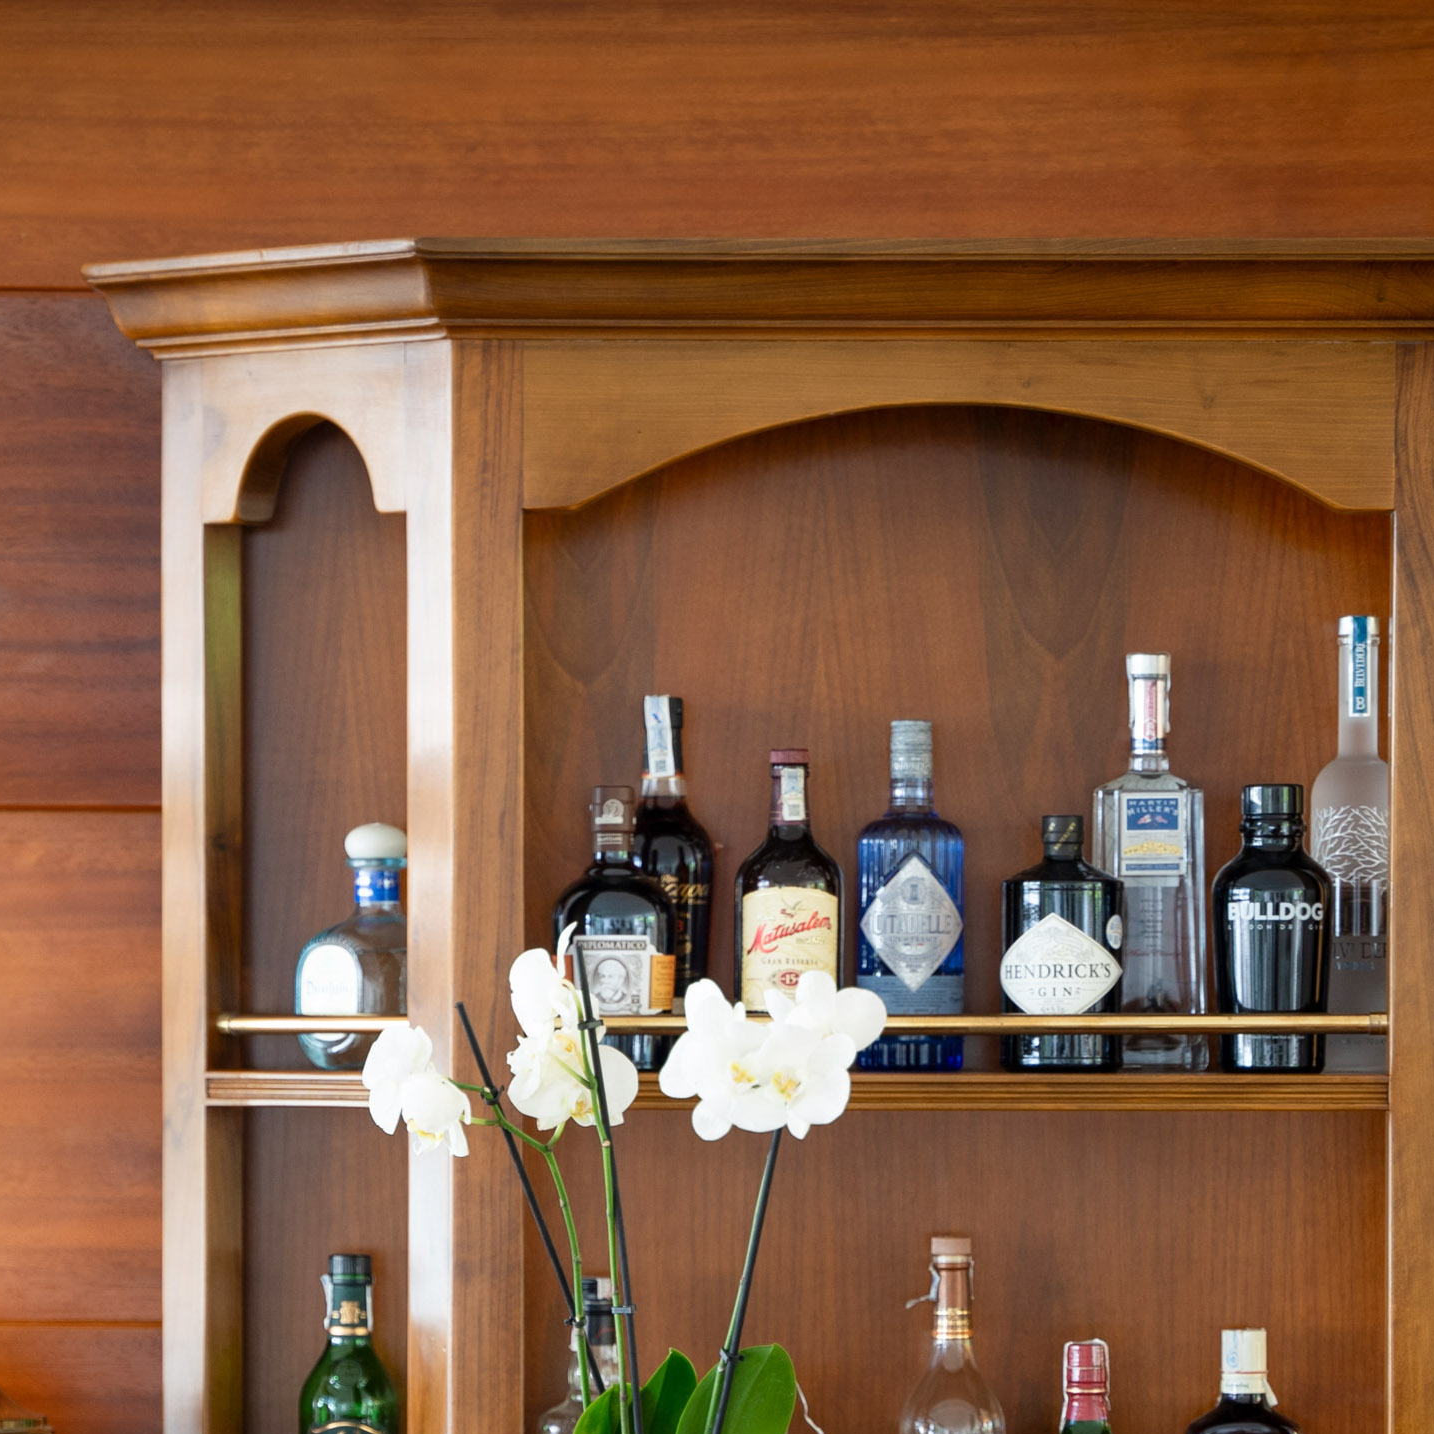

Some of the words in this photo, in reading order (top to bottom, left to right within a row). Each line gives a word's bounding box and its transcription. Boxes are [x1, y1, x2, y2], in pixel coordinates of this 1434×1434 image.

[1127, 805, 1179, 817] MILLER'S
[1228, 902, 1324, 921] BULLDOG
[747, 911, 832, 955] Matusalem
[1005, 962, 1111, 979] HENDRICK'S
[1038, 987, 1073, 997] GIN
